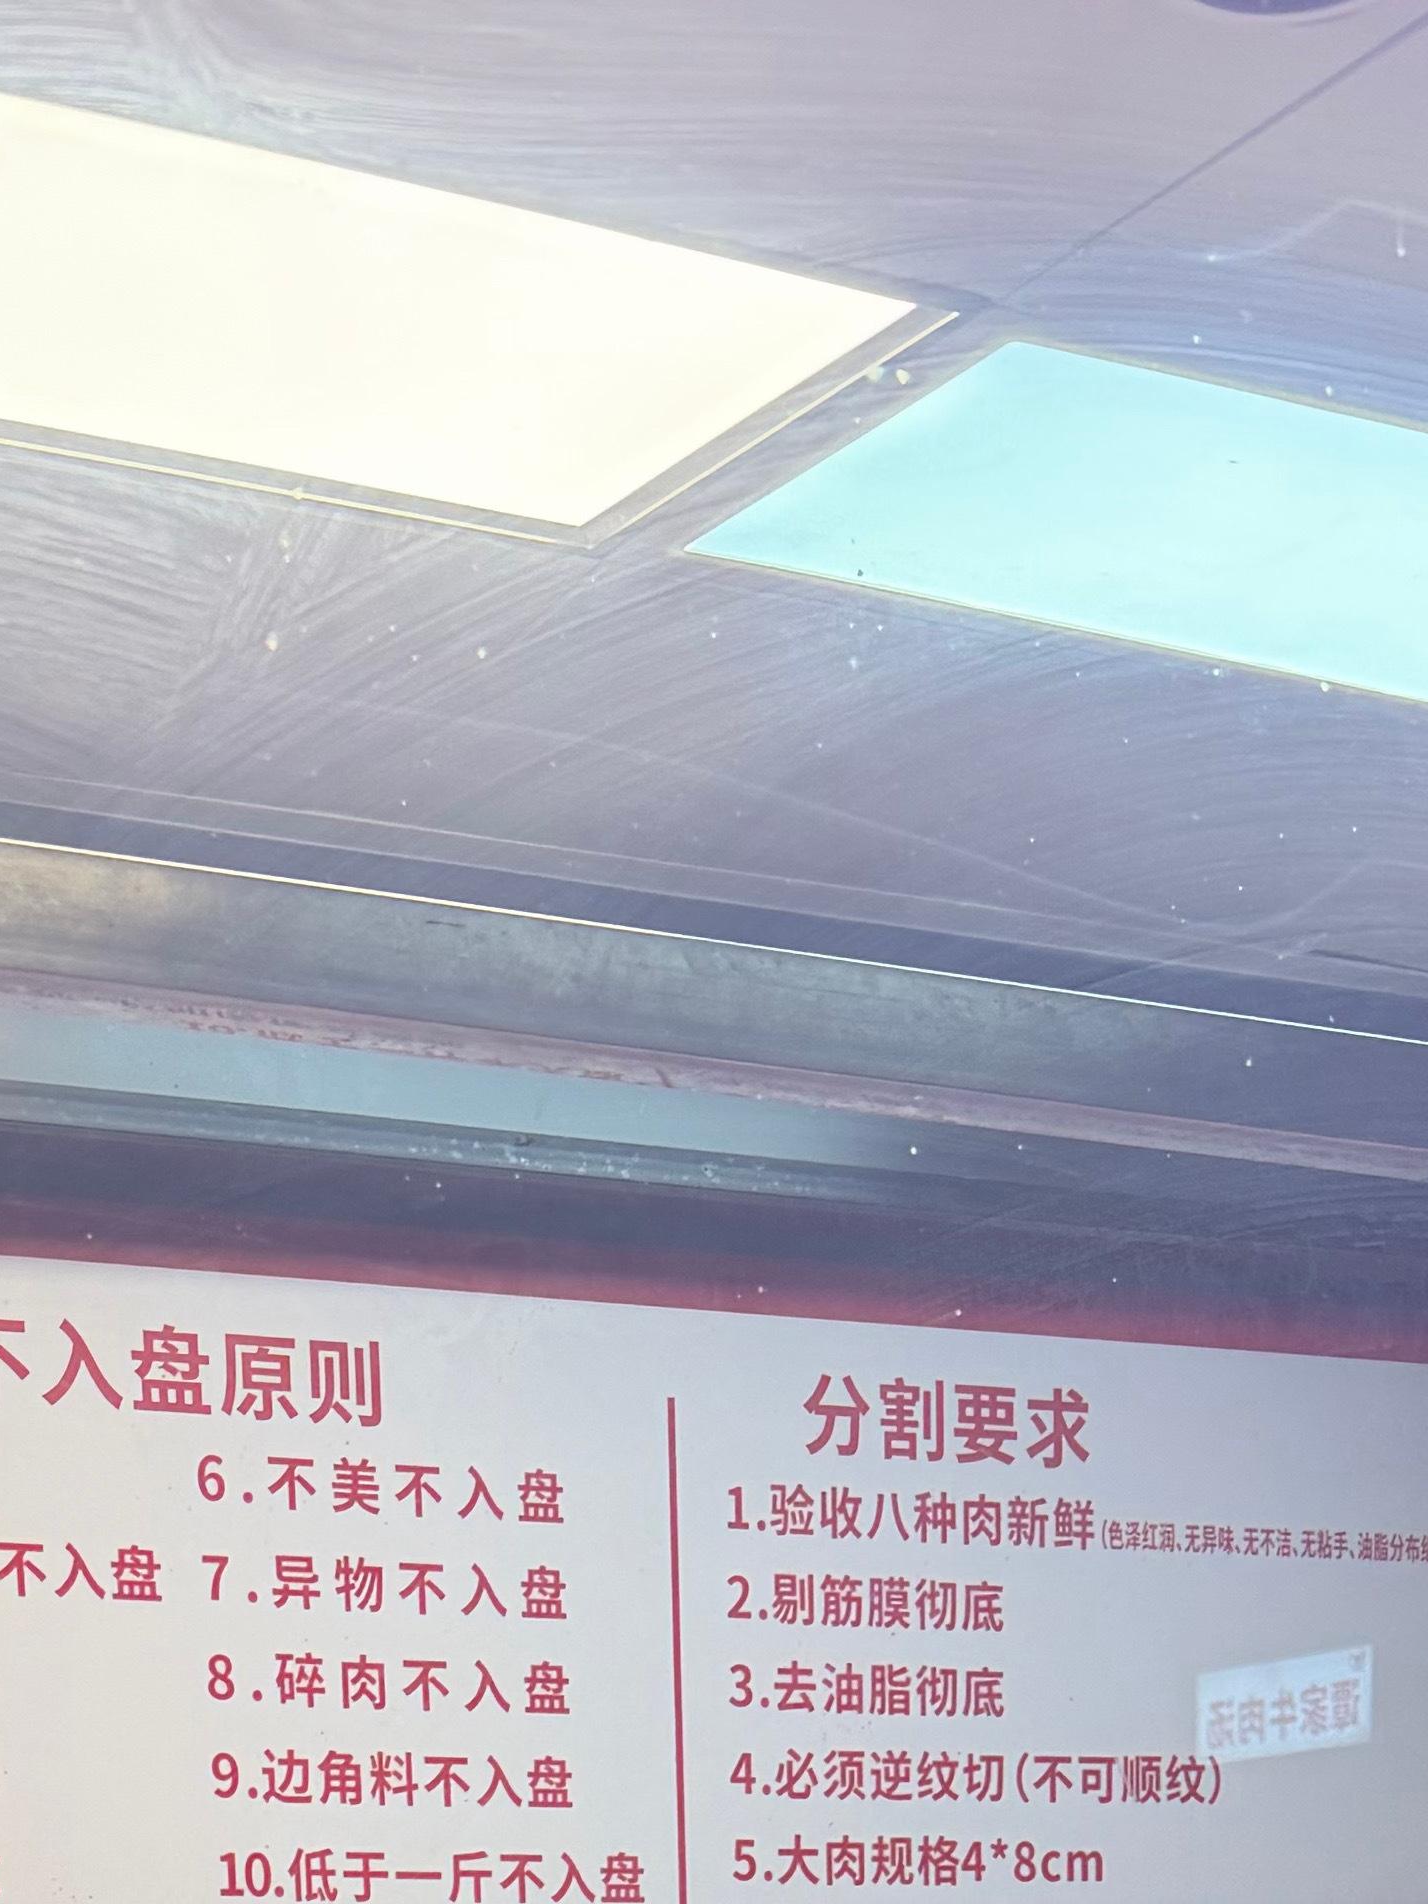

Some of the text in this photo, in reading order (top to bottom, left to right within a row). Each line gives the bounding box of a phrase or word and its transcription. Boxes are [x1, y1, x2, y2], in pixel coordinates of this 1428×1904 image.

[803, 1373, 1091, 1468] 分割要求
[196, 1454, 564, 1525] 6.不美不入盘
[201, 1554, 568, 1621] 7.异物不入盘
[726, 1574, 1005, 1633] 2.剔筋膜彻底
[206, 1652, 570, 1716] 8.碎肉不入盘
[728, 1663, 1005, 1719] 3.去油脂彻底
[210, 1749, 573, 1810] 9.边角料不入盘
[729, 1750, 1223, 1807] 4.必须逆纹切(不可顺纹)
